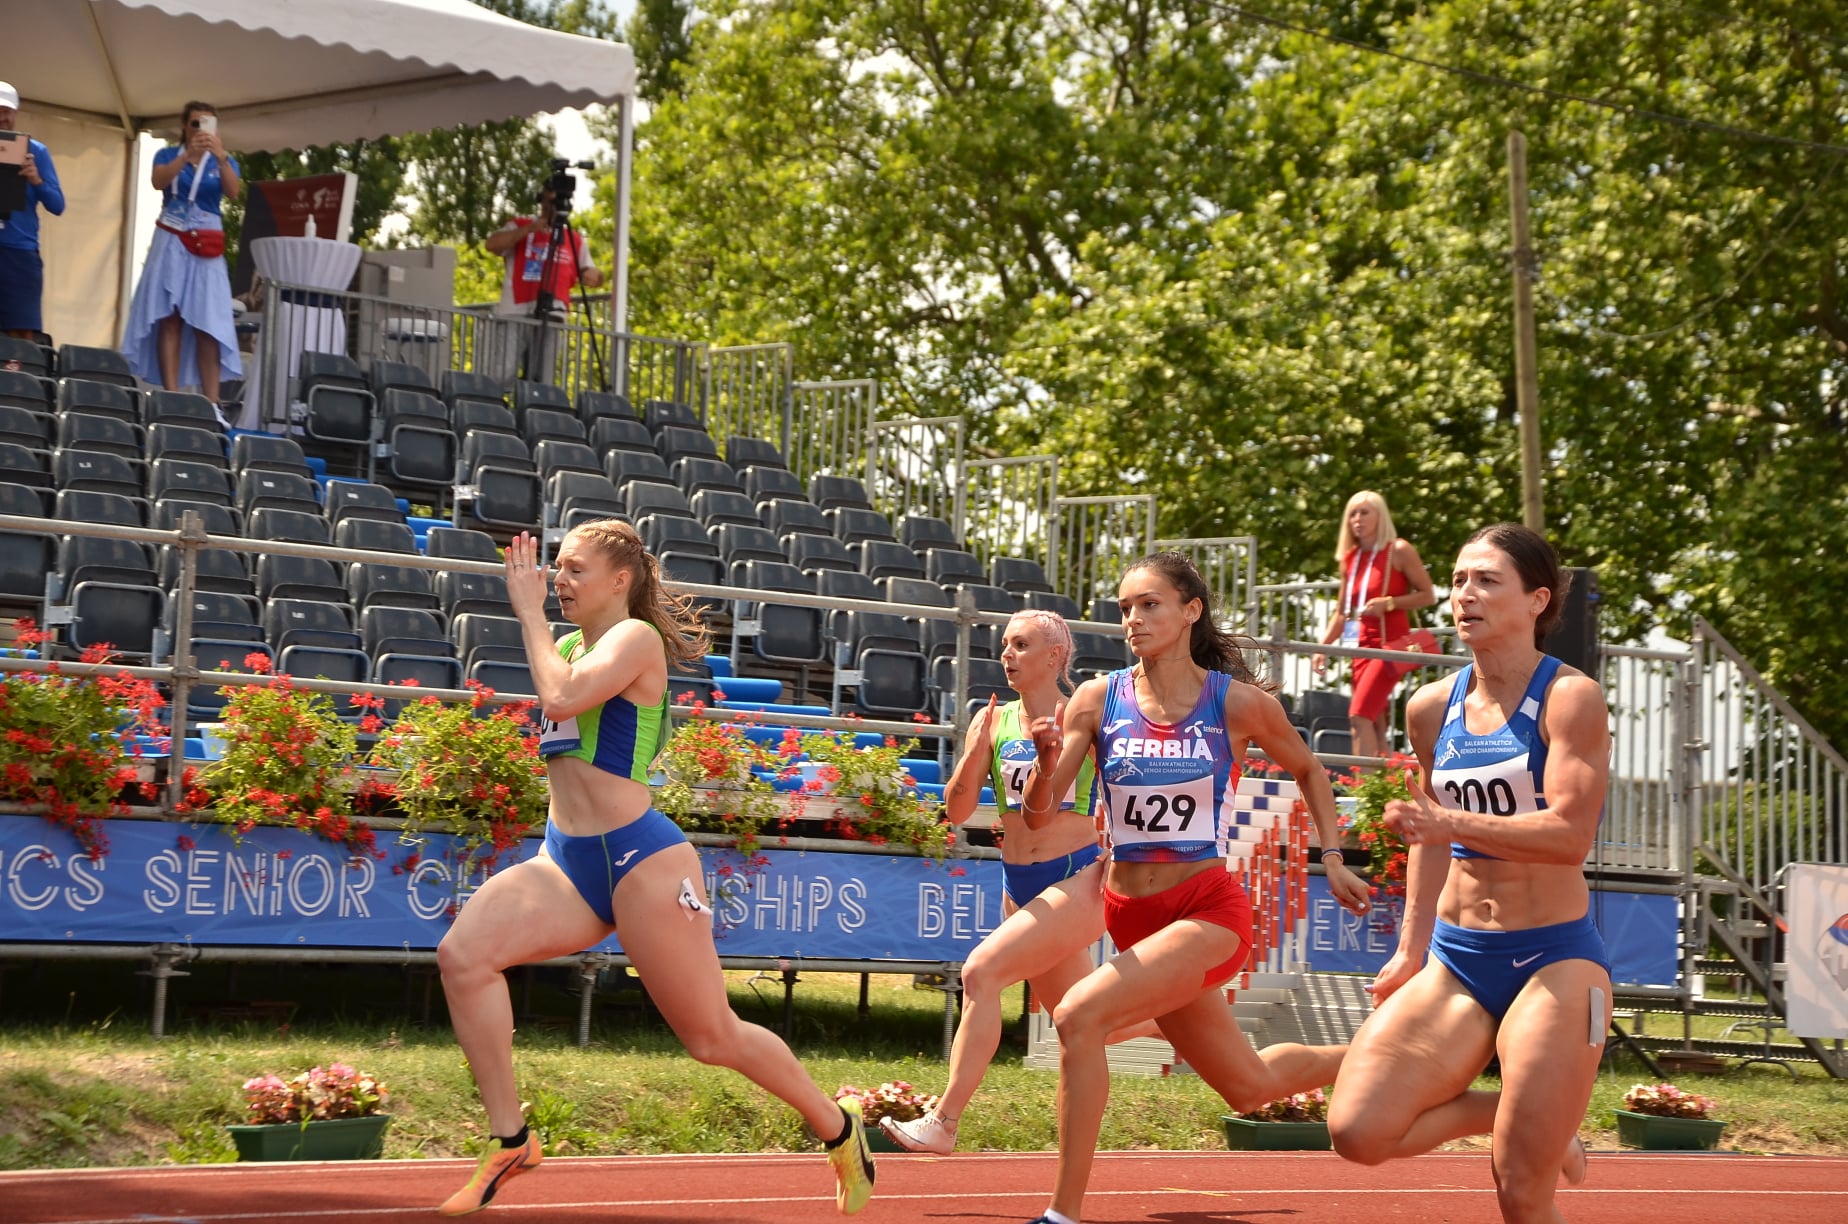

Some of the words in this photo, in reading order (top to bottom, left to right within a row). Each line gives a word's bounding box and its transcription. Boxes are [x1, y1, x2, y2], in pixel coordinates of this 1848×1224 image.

[1203, 725, 1224, 735] telenor
[1111, 737, 1214, 761] SERBIA
[1124, 794, 1197, 832] 429
[144, 849, 375, 918] SENIOR
[918, 882, 1004, 939] BEL
